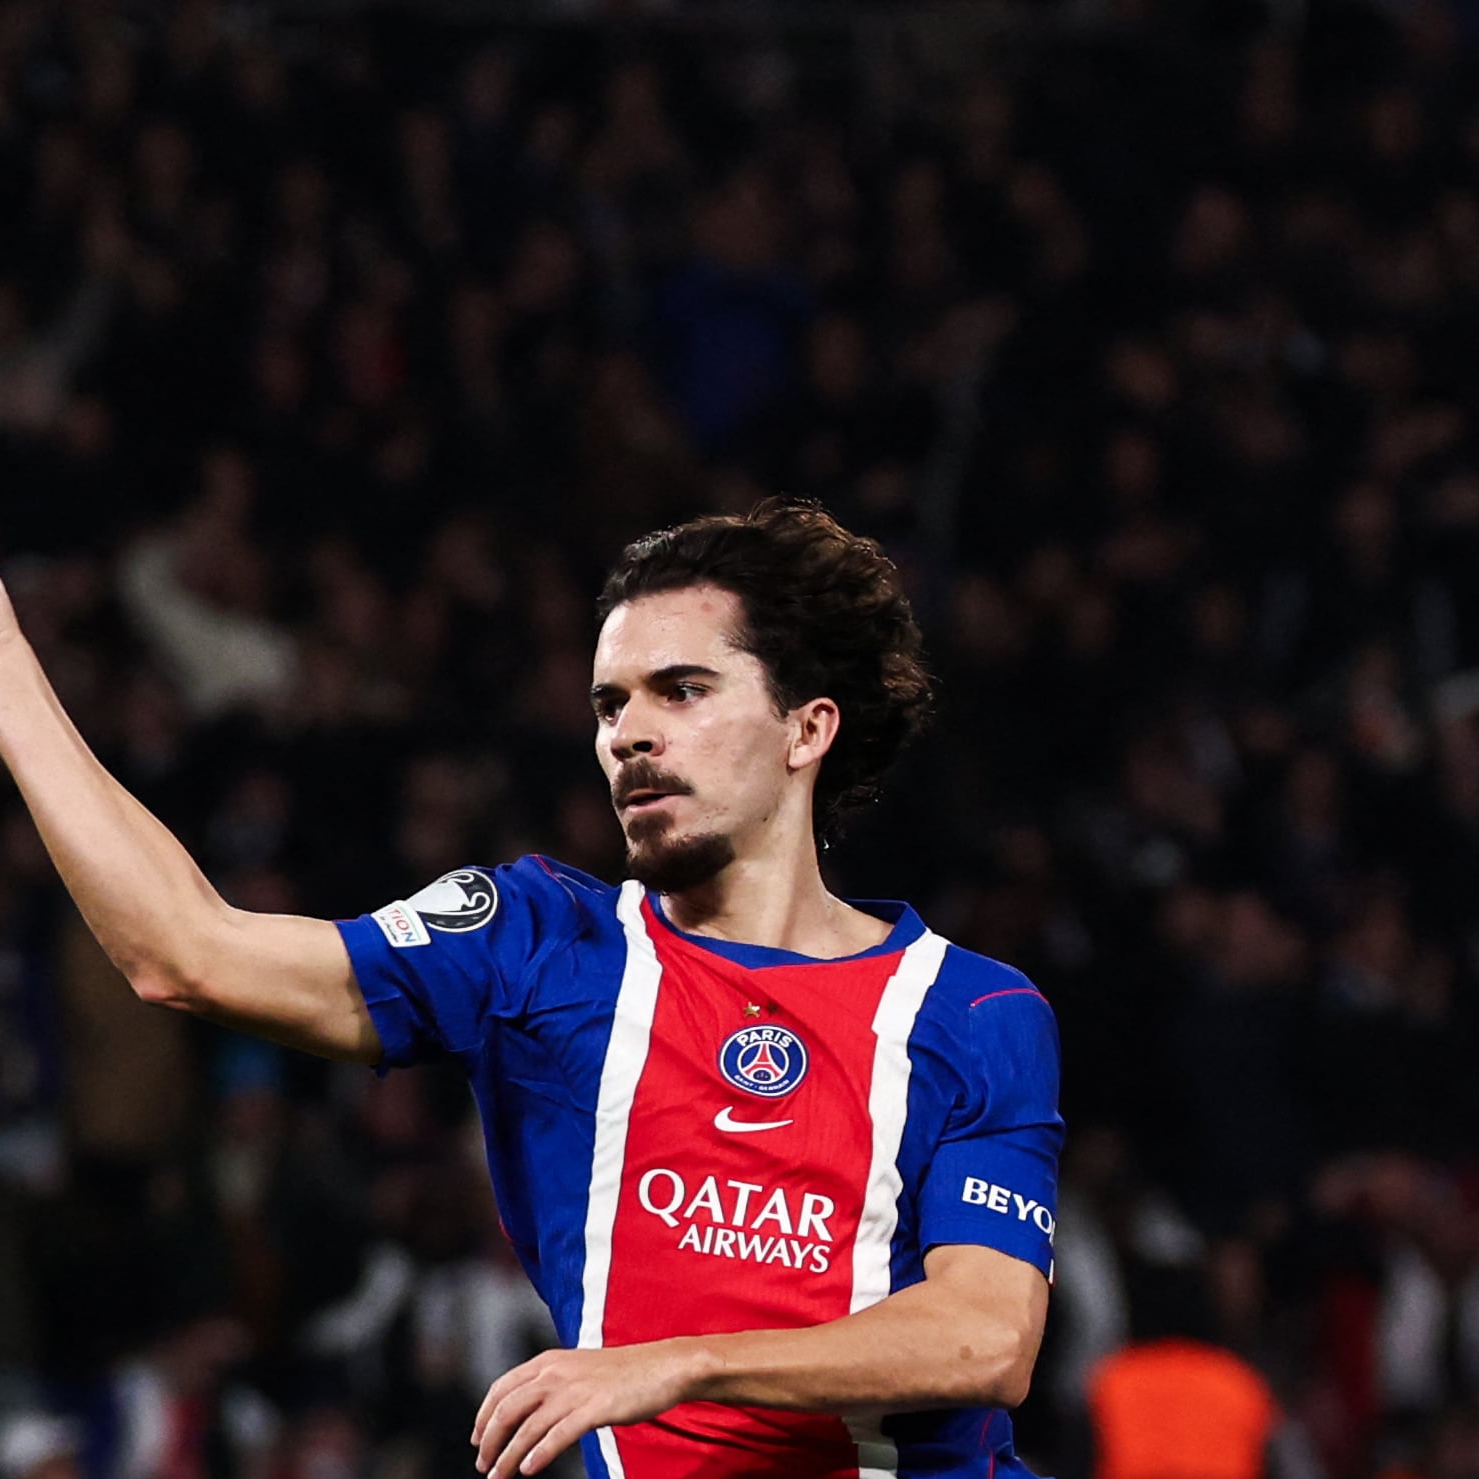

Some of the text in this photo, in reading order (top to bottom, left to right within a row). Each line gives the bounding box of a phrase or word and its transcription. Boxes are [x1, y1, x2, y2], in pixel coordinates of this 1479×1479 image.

[736, 1029, 792, 1048] PARIS
[638, 1168, 835, 1242] QATAR
[961, 1176, 1056, 1246] BEYO
[677, 1223, 831, 1274] AIRWAYS
